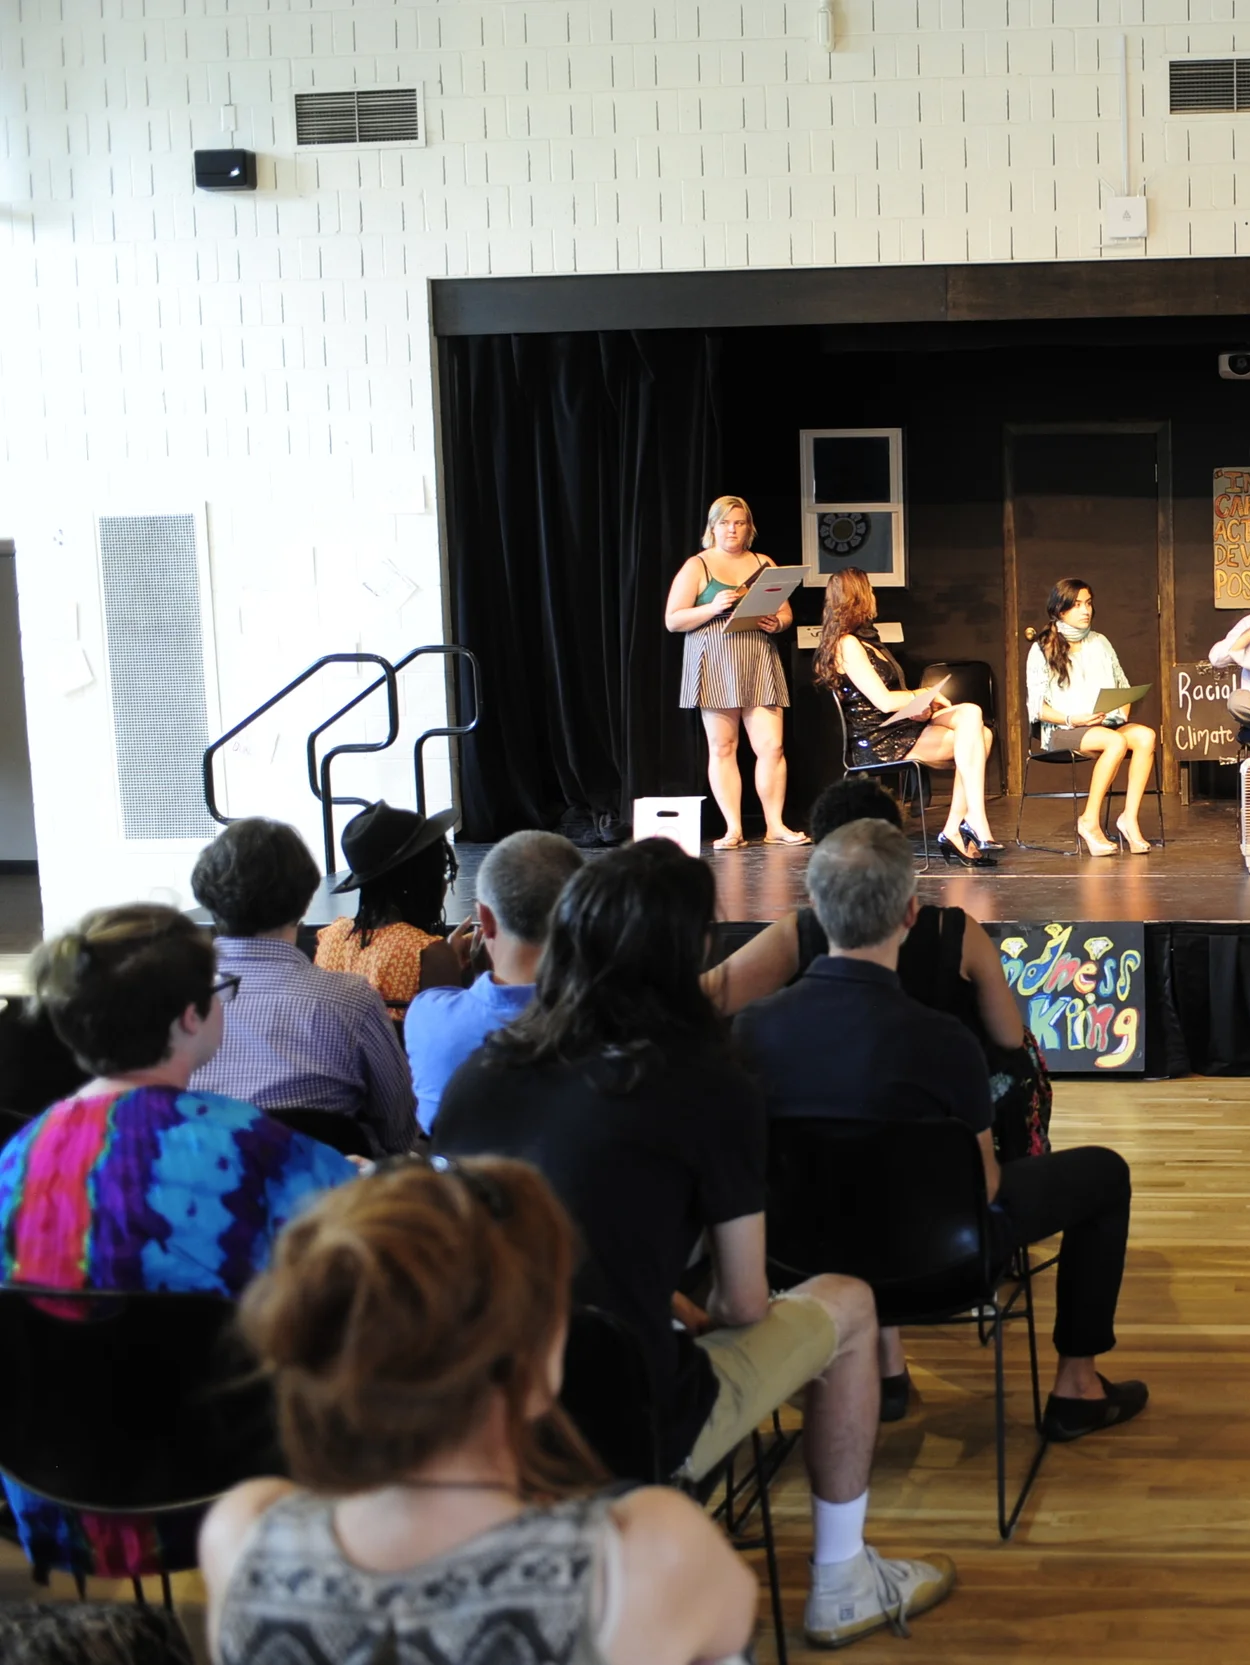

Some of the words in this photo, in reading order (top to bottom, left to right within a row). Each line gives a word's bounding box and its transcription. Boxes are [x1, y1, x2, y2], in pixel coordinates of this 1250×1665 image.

[1178, 671, 1238, 721] Racial
[1175, 725, 1236, 755] Climate
[1028, 993, 1140, 1069] King
